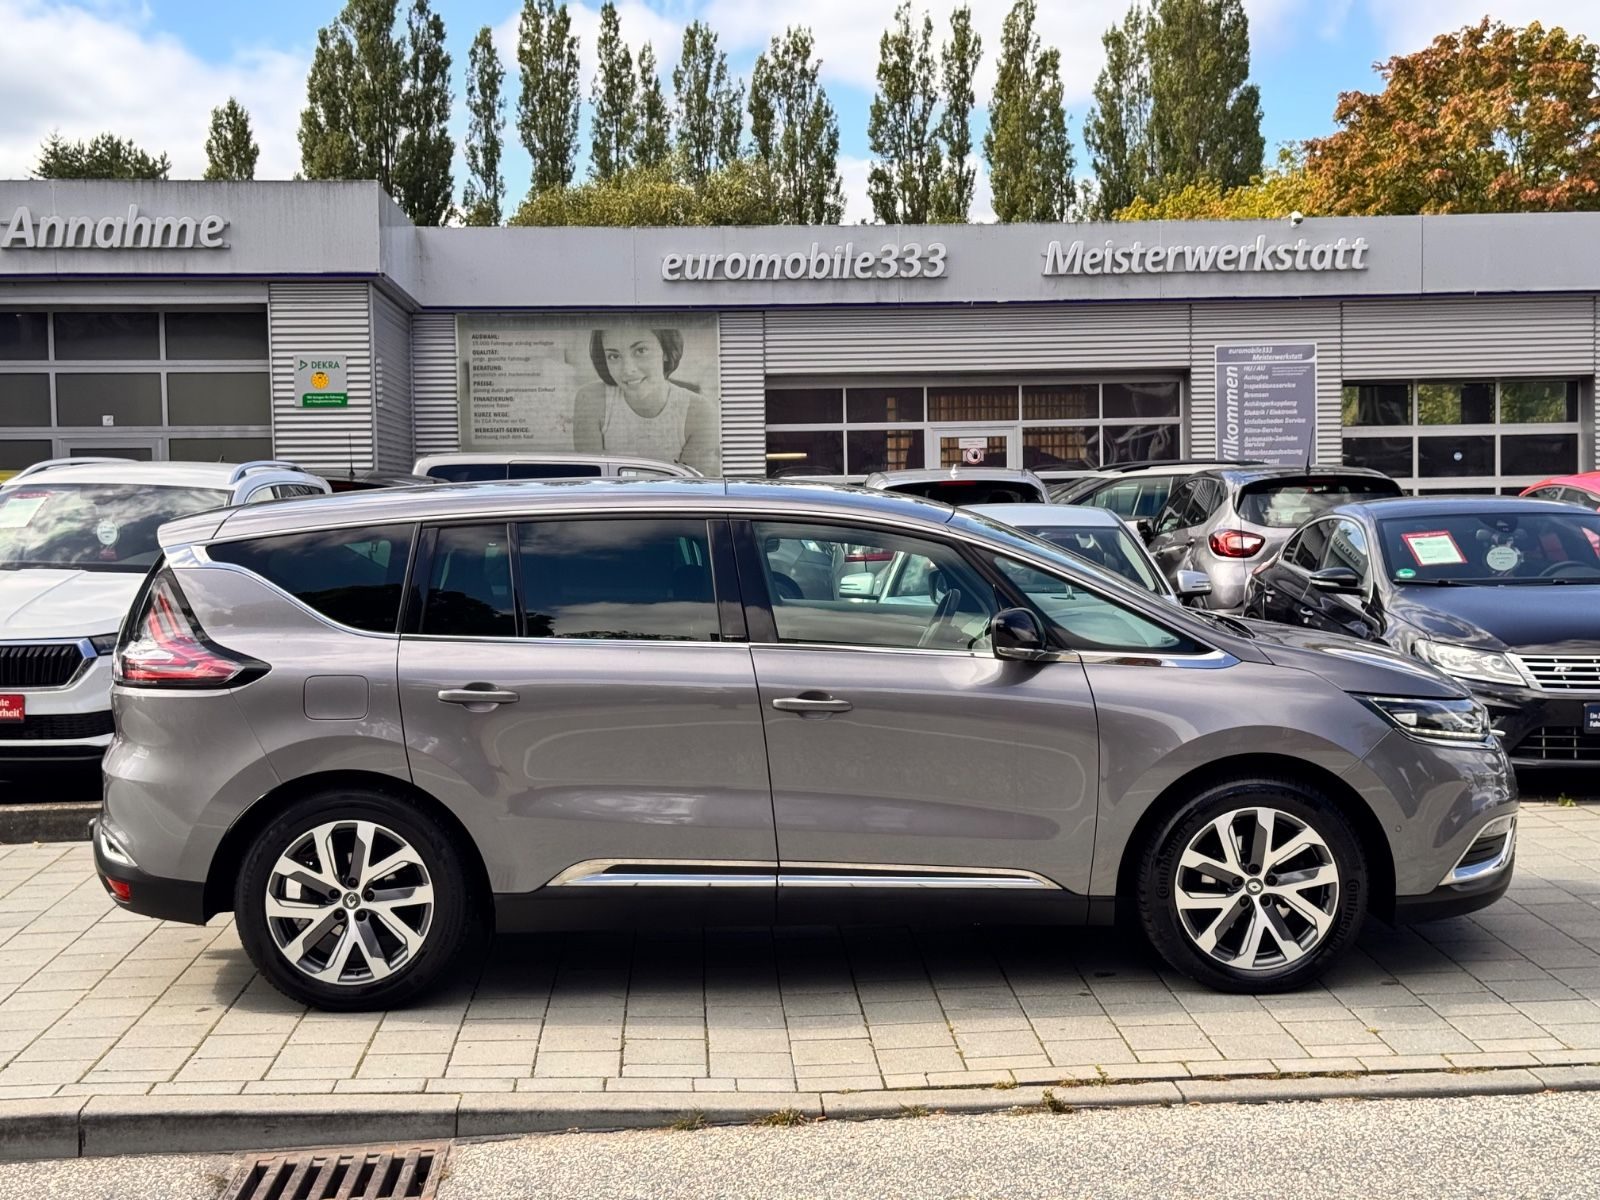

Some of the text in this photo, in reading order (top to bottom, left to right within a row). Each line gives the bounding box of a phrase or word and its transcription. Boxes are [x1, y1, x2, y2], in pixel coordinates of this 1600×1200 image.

[1, 204, 228, 249] Annahme
[661, 242, 947, 280] euromobile333
[1043, 234, 1368, 275] Meisterwerkstatt
[311, 360, 340, 370] DEKRA
[1228, 347, 1272, 355] euromobile333
[1252, 353, 1303, 361] Meisterwerkstatt
[1223, 366, 1239, 461] ilkommen
